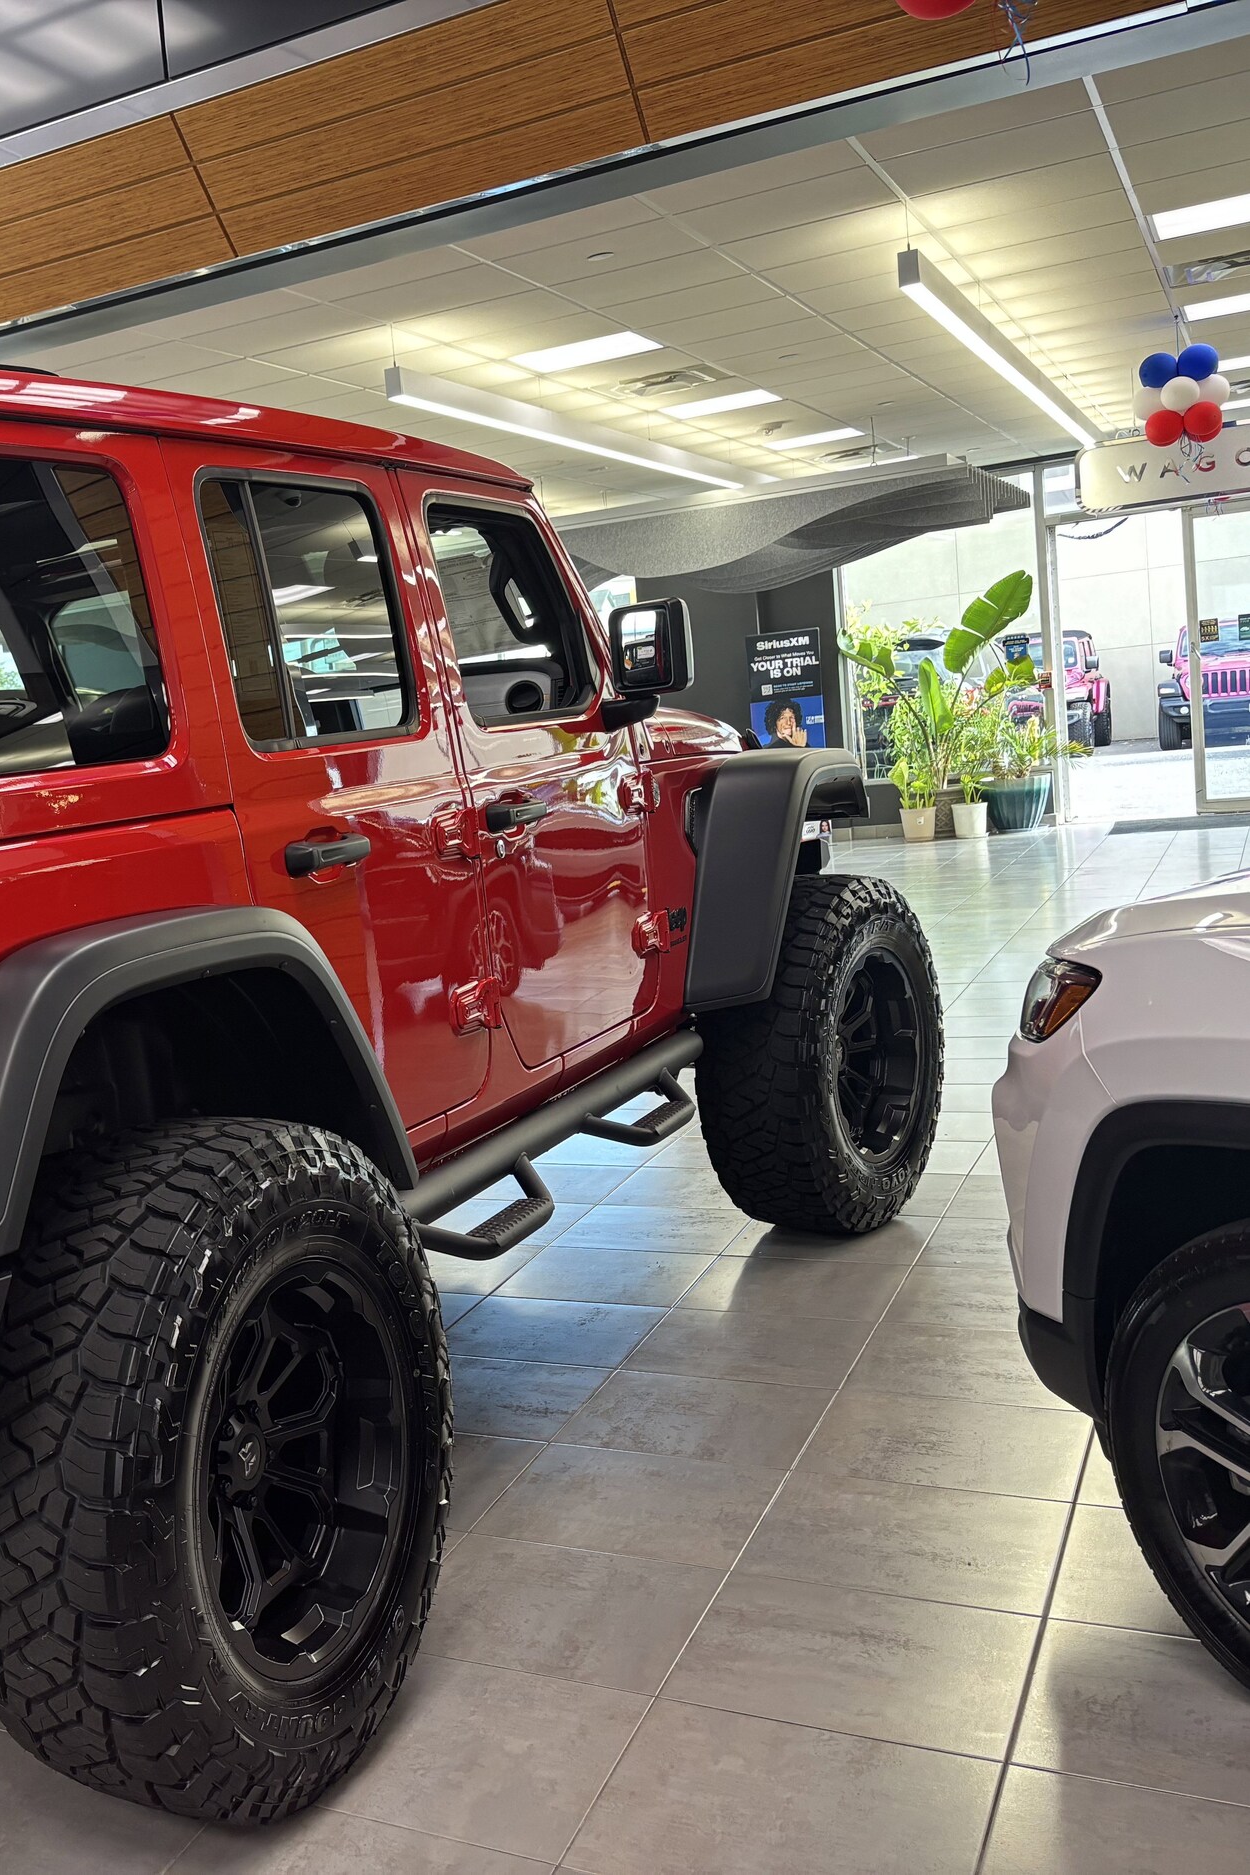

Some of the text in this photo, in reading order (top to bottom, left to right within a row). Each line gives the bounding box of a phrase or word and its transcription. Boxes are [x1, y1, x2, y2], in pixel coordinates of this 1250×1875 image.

[756, 635, 810, 650] SiriusXM
[750, 656, 819, 672] YOUR TRIAL
[770, 667, 801, 678] IS ON
